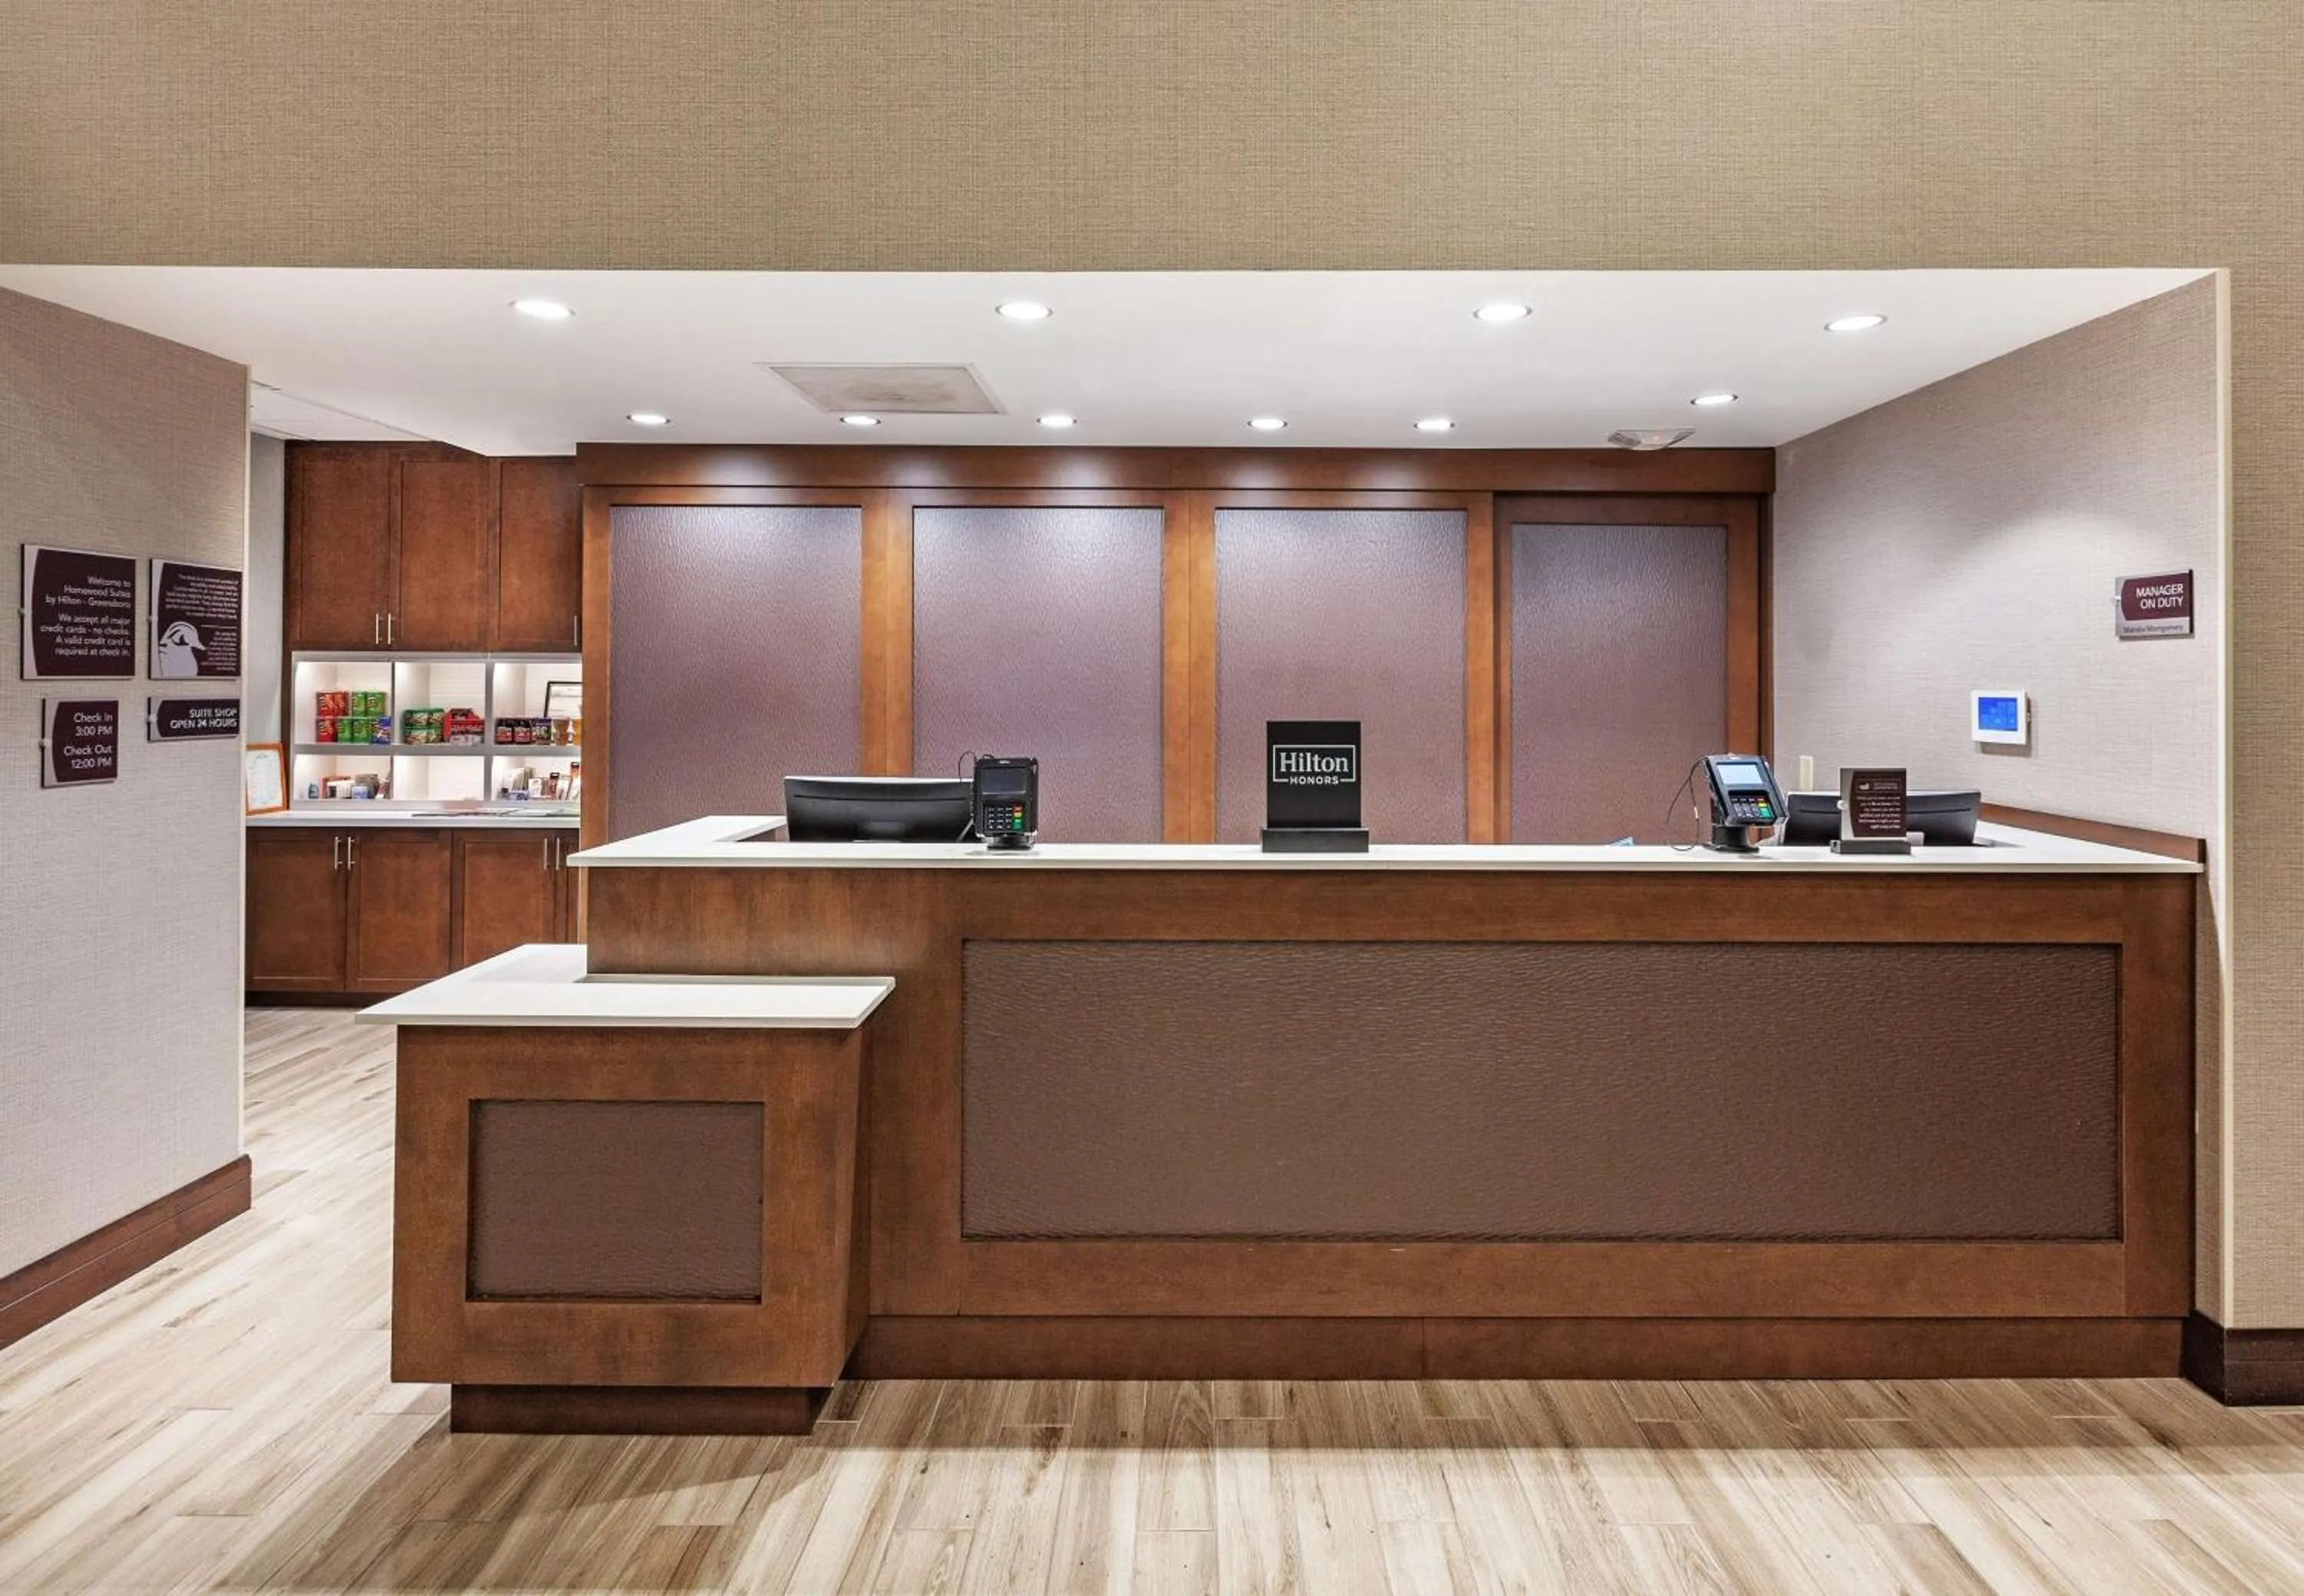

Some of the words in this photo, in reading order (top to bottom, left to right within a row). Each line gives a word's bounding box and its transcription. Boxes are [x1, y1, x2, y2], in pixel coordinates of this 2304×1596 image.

[88, 576, 122, 586] Welcome
[65, 584, 108, 595] Homewood
[111, 588, 131, 598] Suites
[2136, 584, 2183, 598] MANAGER
[45, 594, 55, 606] by
[58, 595, 81, 604] Hilton
[88, 597, 131, 608] Greensboro
[2140, 599, 2156, 609] ON
[2158, 596, 2183, 608] DUTY
[58, 614, 71, 622] We
[74, 616, 98, 624] accept
[101, 615, 109, 624] all
[111, 616, 130, 625] major
[40, 624, 63, 633] credit
[65, 625, 86, 634] cards
[55, 647, 88, 656] required
[74, 712, 101, 723] Check
[104, 714, 113, 722] In
[189, 709, 212, 717] SUITE
[215, 708, 237, 717] SHOP
[170, 720, 195, 729] OPEN
[197, 720, 207, 728] 24
[209, 719, 237, 727] HOURS
[75, 726, 94, 736] 3:00
[97, 725, 113, 735] PM
[64, 746, 91, 757] Check
[95, 743, 112, 754] Out
[71, 758, 94, 769] 12:00
[98, 757, 112, 767] PM
[1279, 752, 1349, 772] Hilton
